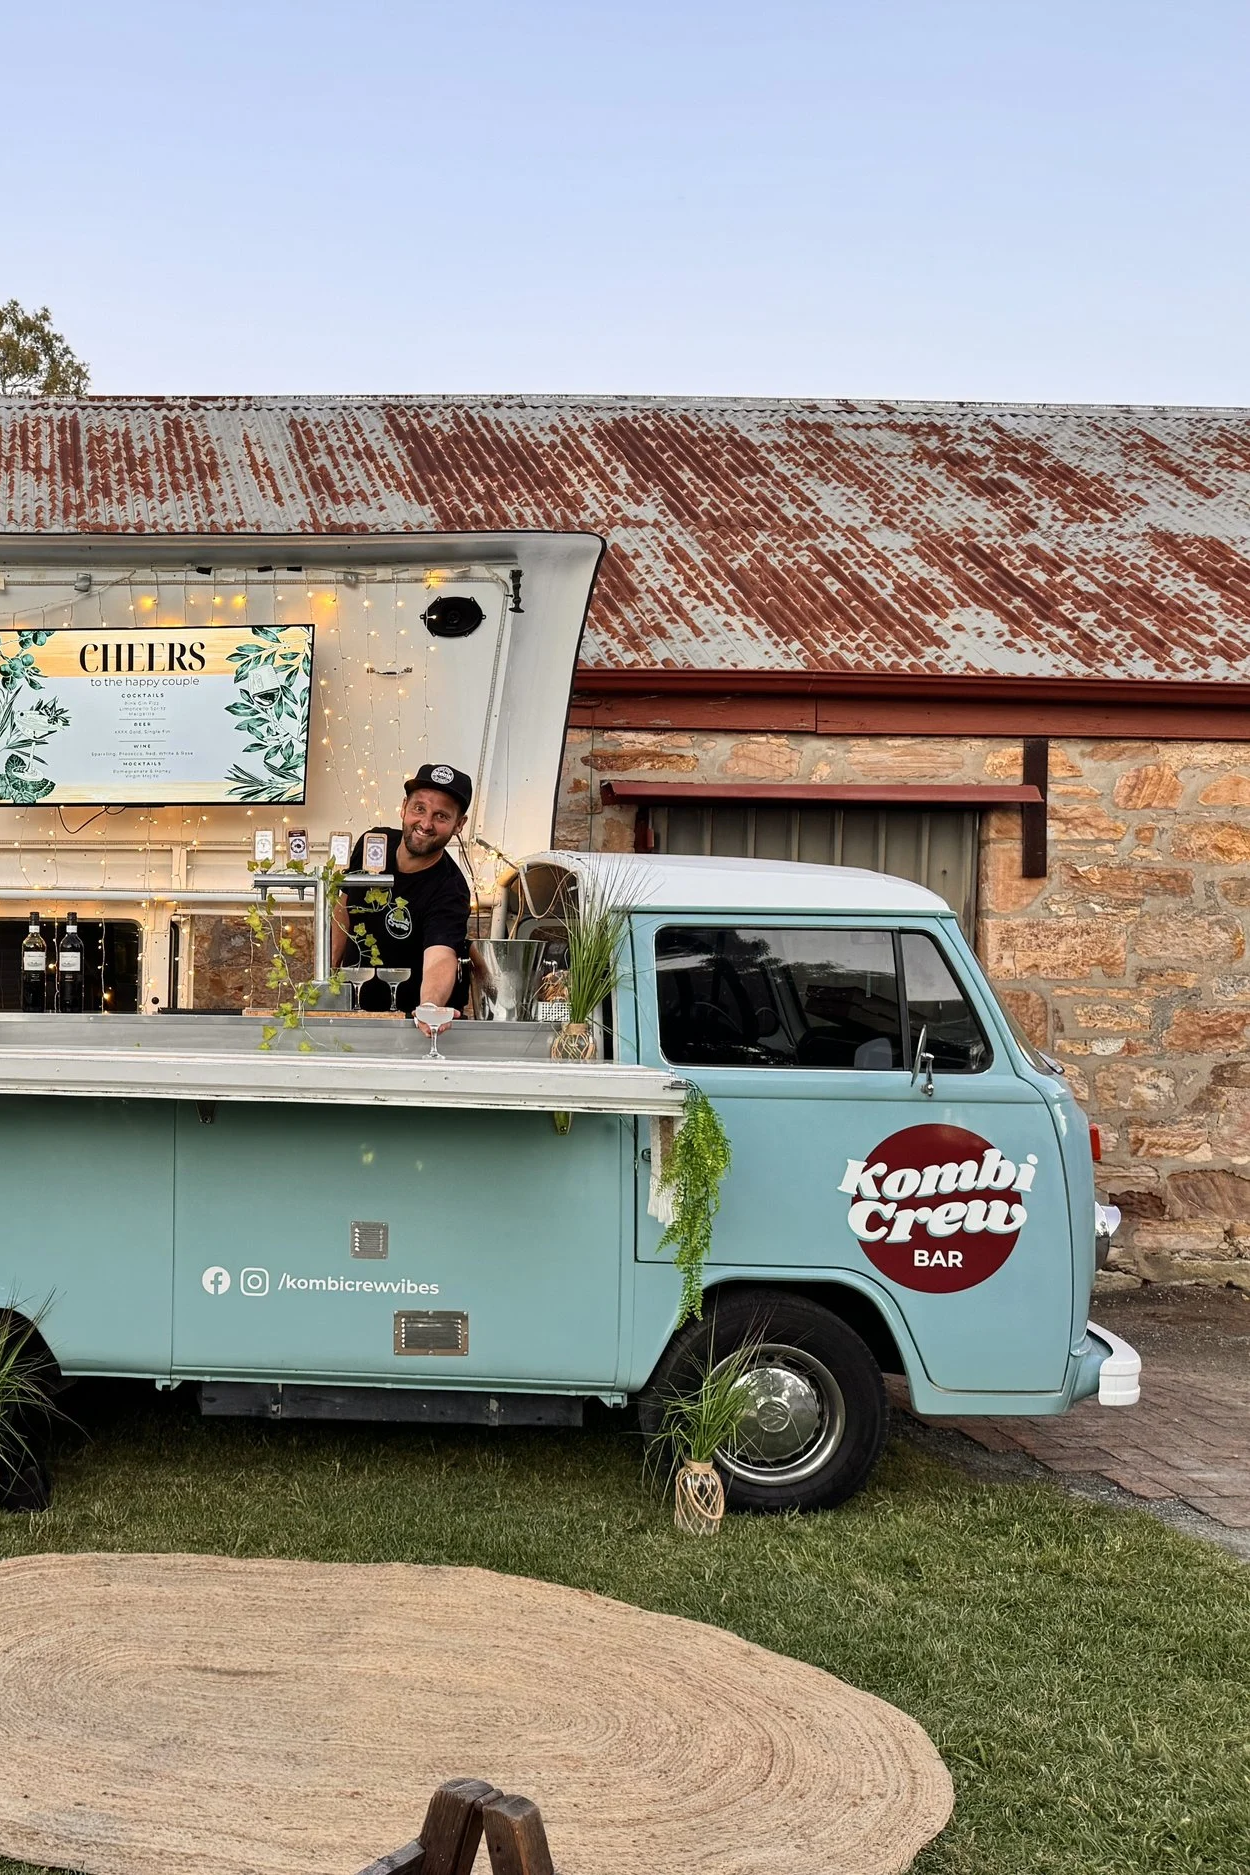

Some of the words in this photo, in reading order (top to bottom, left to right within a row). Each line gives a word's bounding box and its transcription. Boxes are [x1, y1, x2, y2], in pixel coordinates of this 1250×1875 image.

[79, 641, 206, 673] CHEERS
[90, 678, 101, 687] to
[104, 677, 123, 687] the
[125, 677, 160, 689] happy
[161, 676, 200, 688] couple
[836, 1148, 1039, 1200] Kombi
[847, 1199, 1028, 1244] Crew
[913, 1249, 963, 1268] BAR
[277, 1272, 440, 1295] /kombicrewvibes
